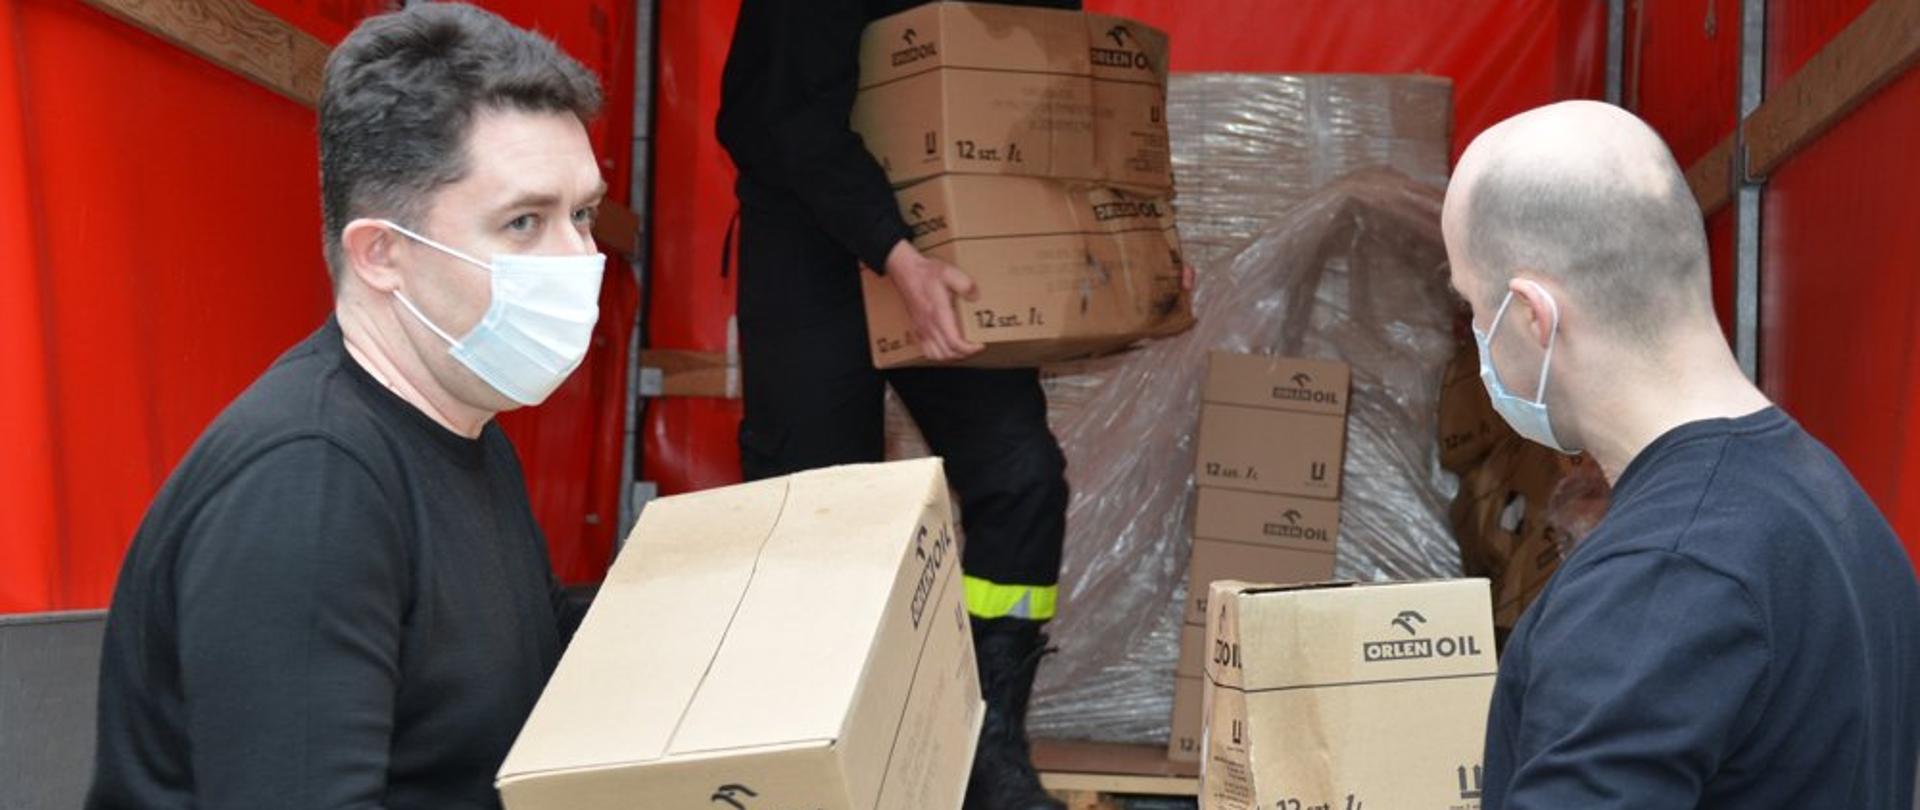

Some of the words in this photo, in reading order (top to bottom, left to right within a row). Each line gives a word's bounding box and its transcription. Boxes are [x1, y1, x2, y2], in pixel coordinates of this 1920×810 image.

[956, 140, 975, 159] 12
[975, 309, 995, 328] 12
[1313, 391, 1339, 405] OIL
[1206, 462, 1221, 477] 12
[1304, 527, 1329, 542] OIL
[1363, 638, 1432, 662] ORLEN
[1436, 636, 1482, 657] OIL
